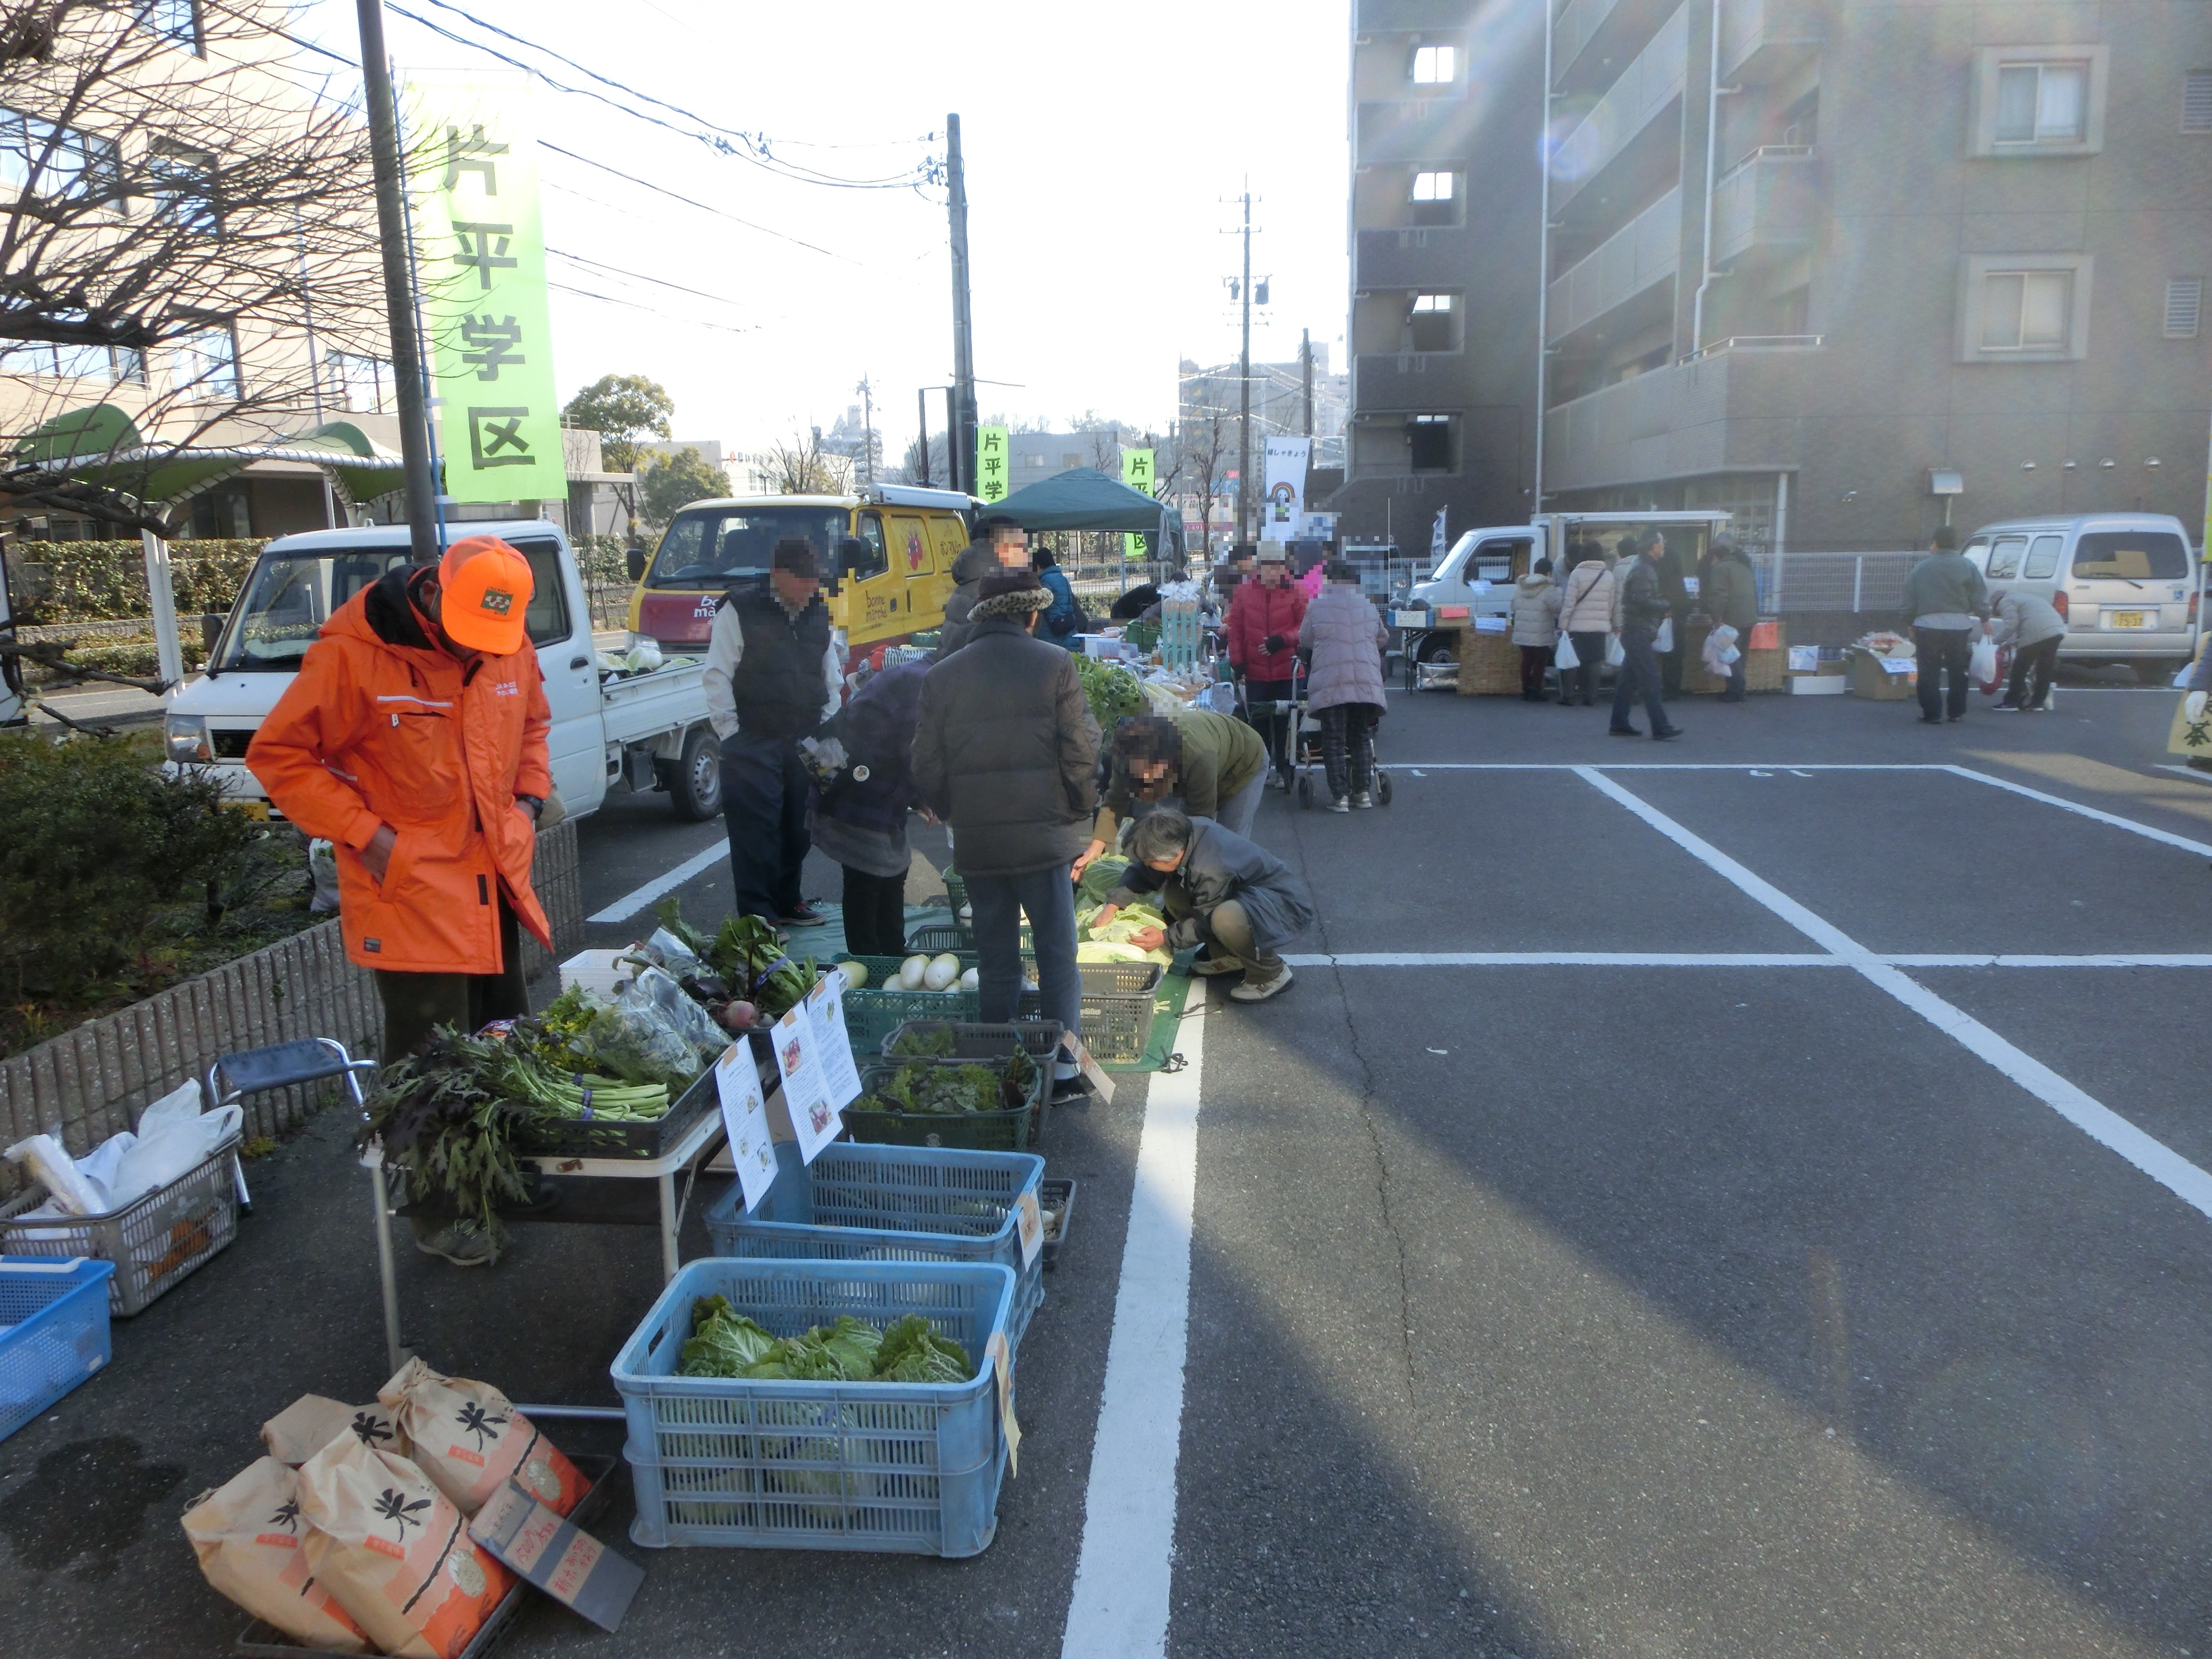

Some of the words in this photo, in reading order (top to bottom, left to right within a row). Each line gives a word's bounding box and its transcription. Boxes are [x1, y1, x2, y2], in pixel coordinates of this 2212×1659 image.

[443, 124, 536, 470] 片平学区
[456, 1401, 507, 1452] 米
[372, 1489, 432, 1542] 米
